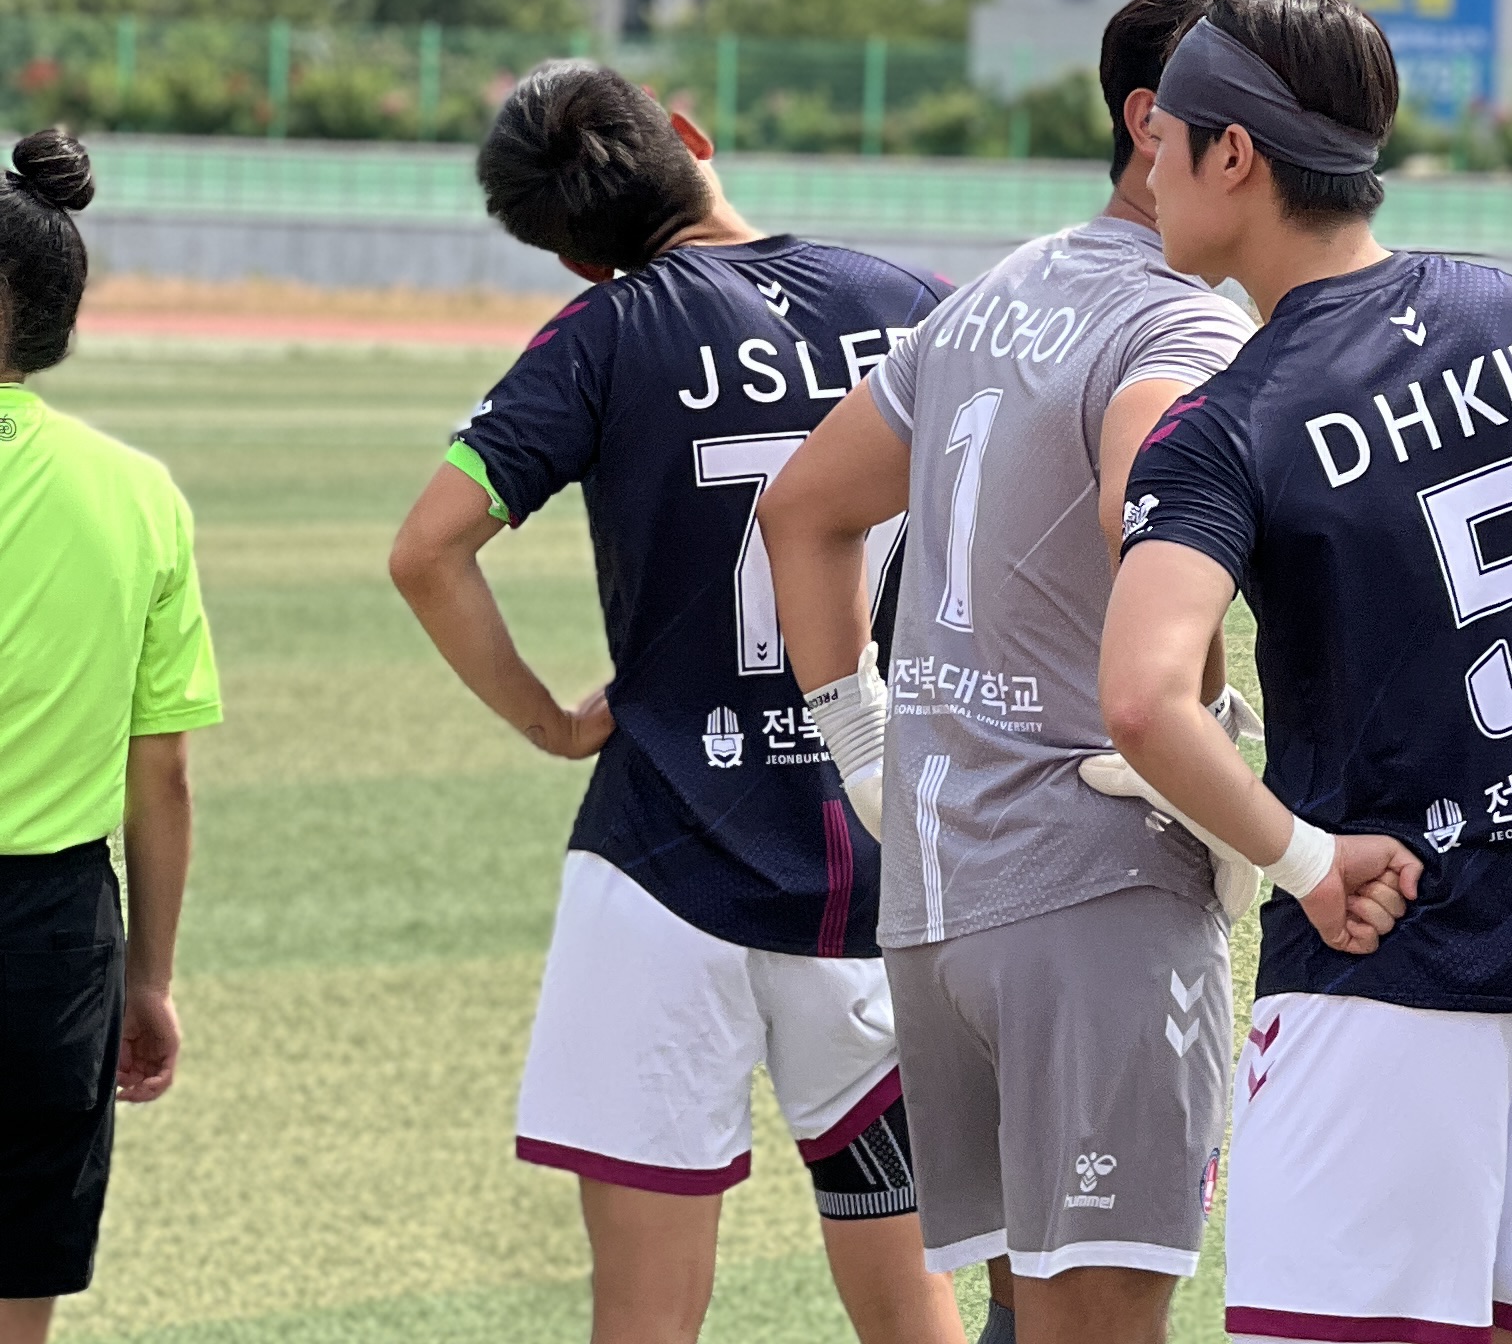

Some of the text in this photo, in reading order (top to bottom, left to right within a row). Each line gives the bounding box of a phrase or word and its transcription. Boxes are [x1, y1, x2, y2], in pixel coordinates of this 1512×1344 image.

[990, 299, 1094, 364] CHOI
[936, 386, 1004, 634] 1
[894, 655, 1045, 717] 전북대학교
[765, 752, 820, 765] JEONBUK
